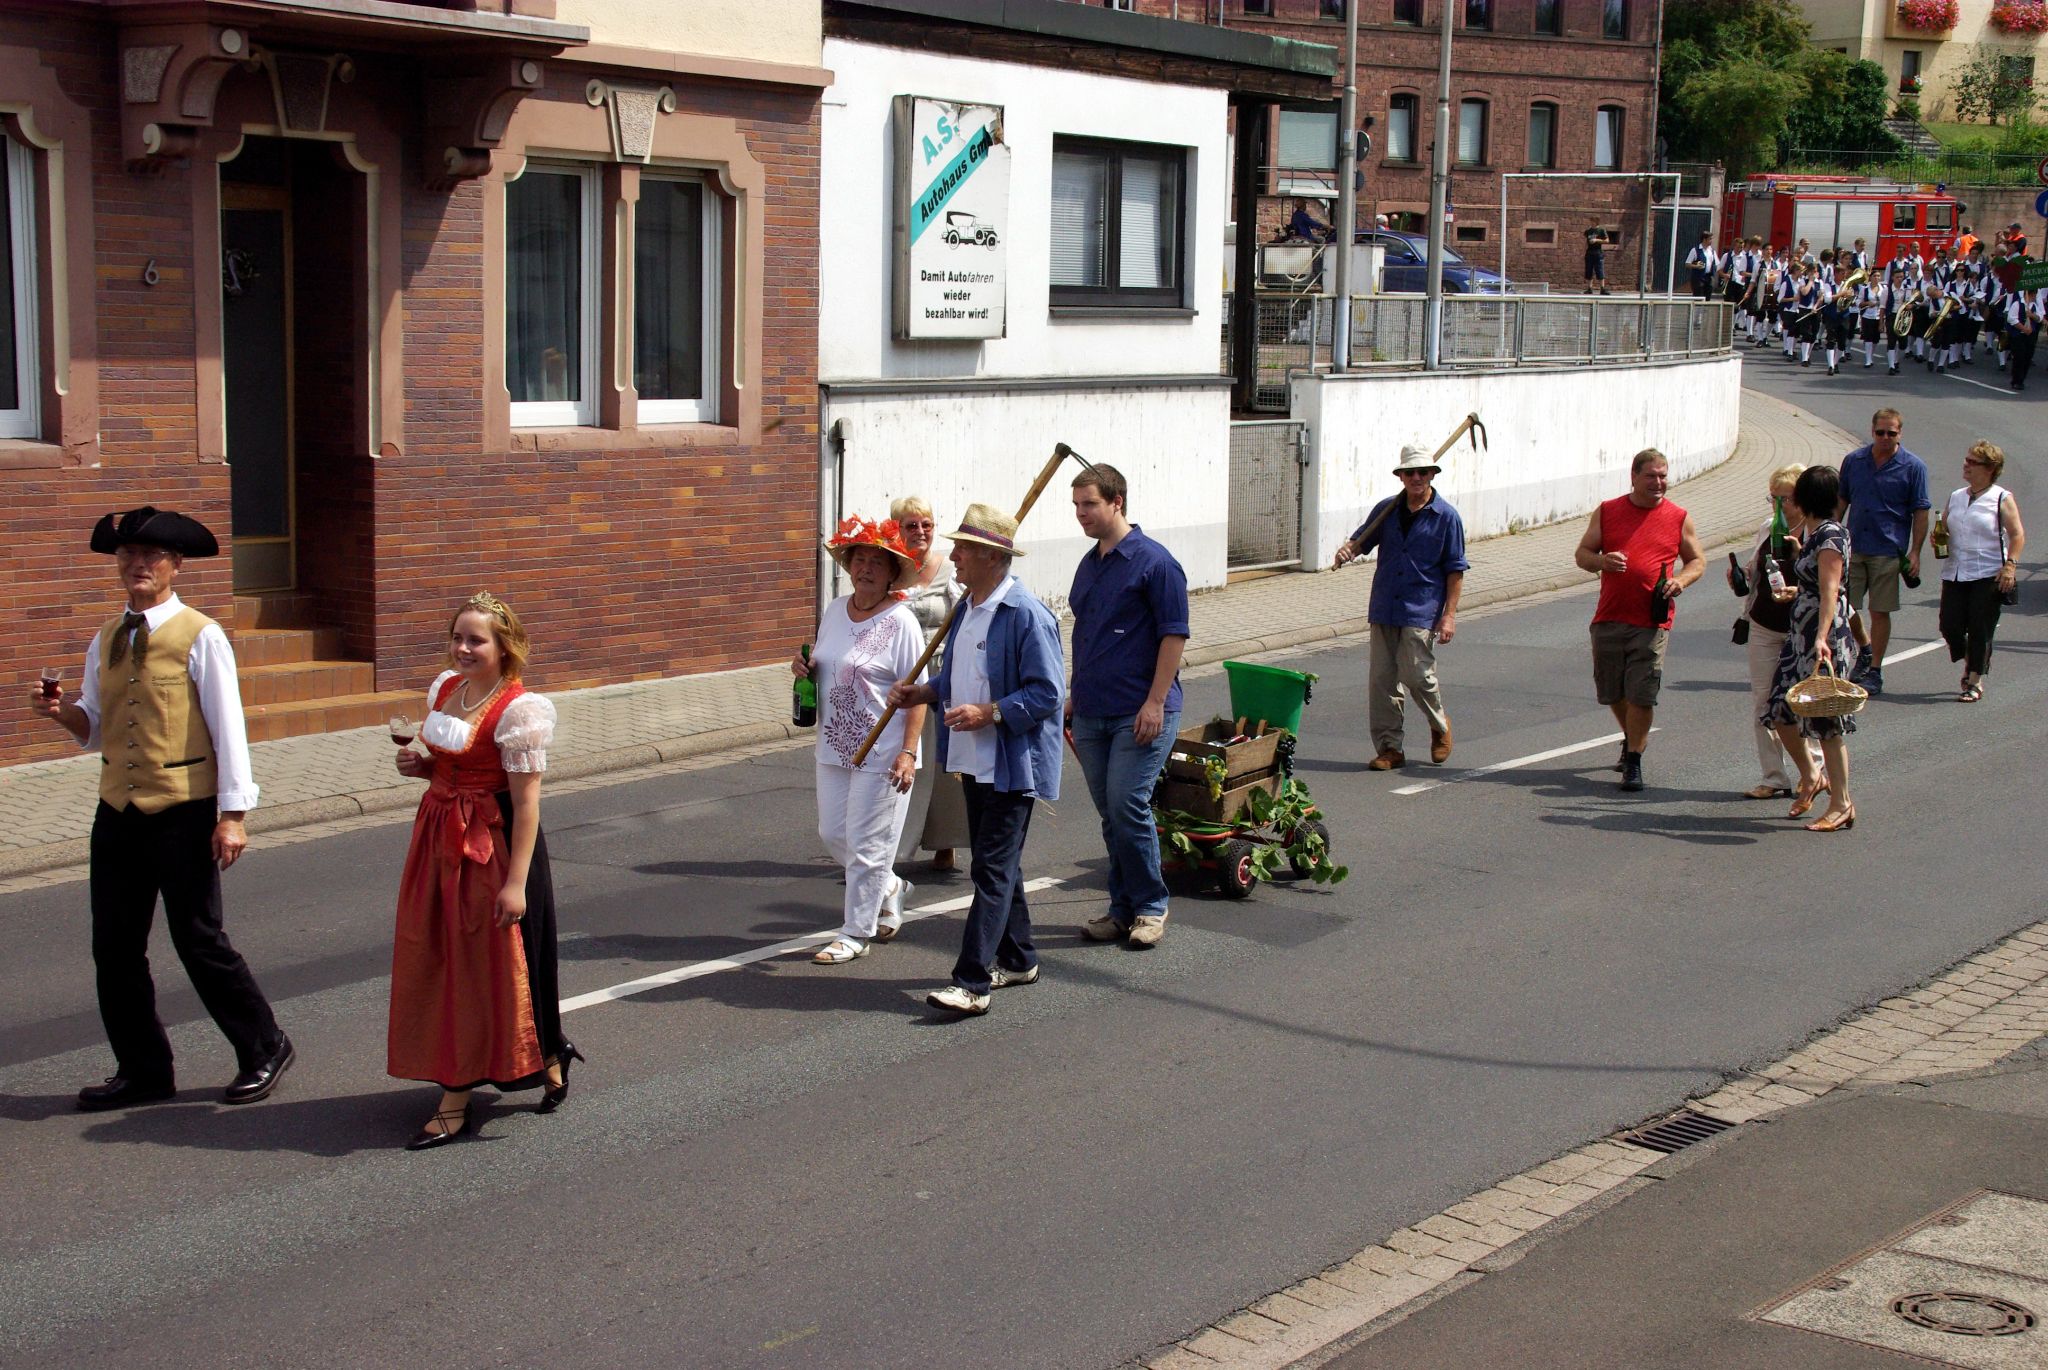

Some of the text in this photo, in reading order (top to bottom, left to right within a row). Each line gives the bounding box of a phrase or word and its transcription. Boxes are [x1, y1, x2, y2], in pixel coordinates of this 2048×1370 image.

[920, 160, 968, 223] Autohaus
[144, 259, 160, 285] 6
[921, 270, 994, 283] Damit Autofahren
[943, 289, 972, 301] wieder
[925, 307, 989, 319] bezahlbar wird!
